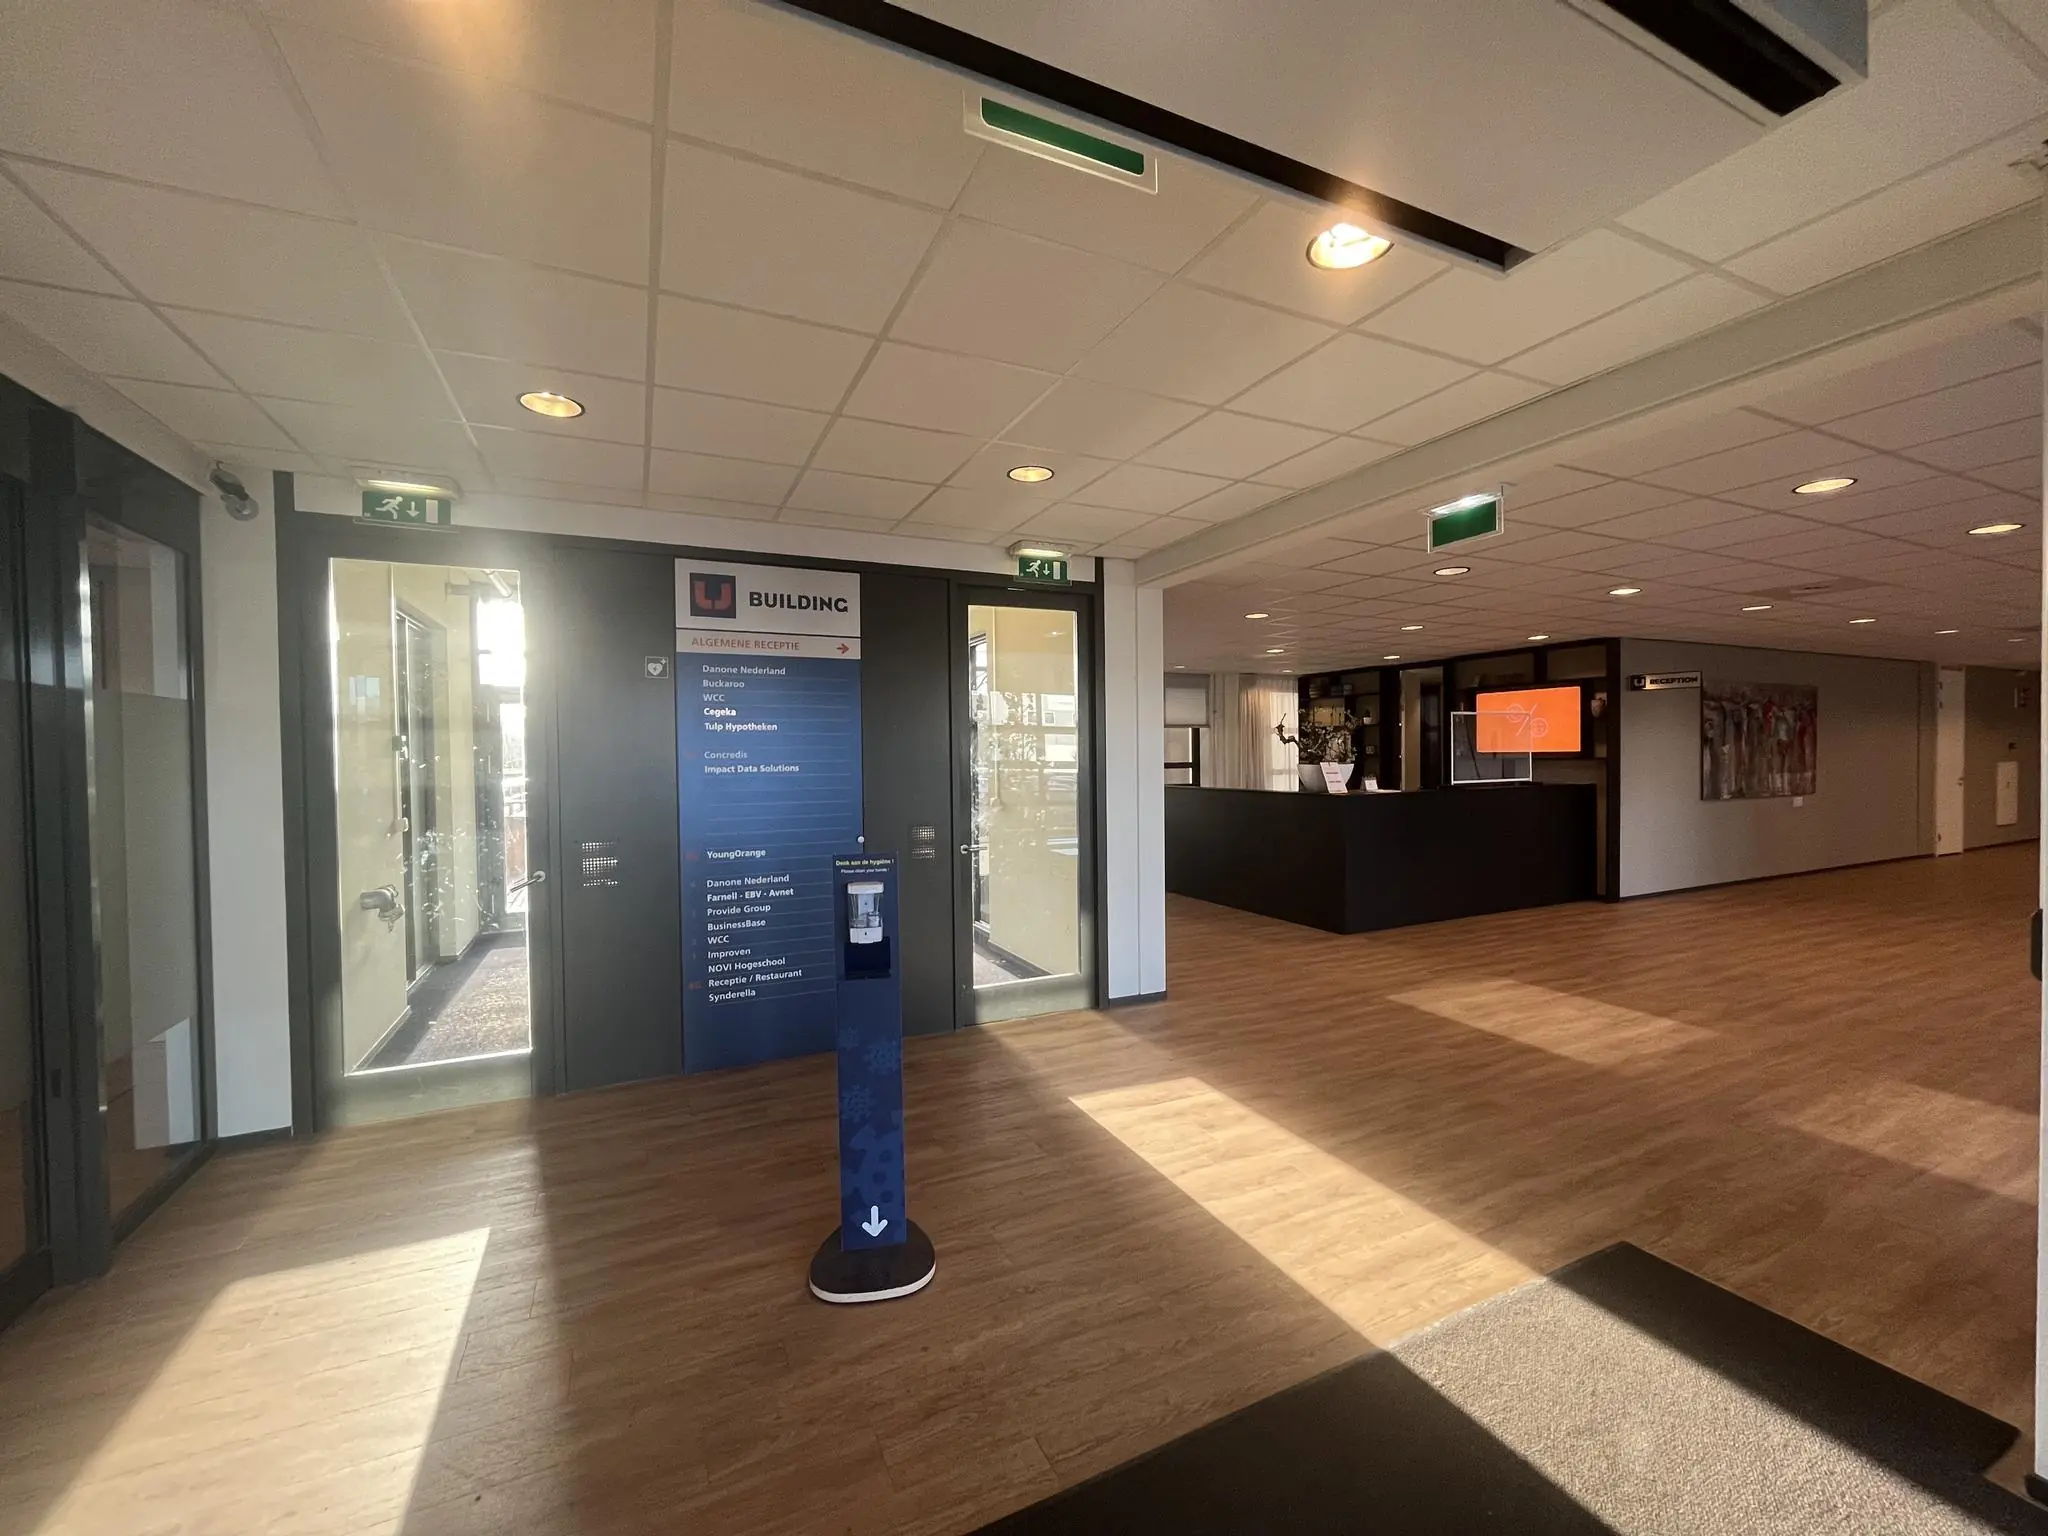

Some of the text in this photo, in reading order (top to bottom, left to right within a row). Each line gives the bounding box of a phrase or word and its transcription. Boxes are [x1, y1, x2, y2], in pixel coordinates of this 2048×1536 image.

[749, 592, 848, 612] BUILDING
[692, 637, 800, 650] ALGEMENE RECEPTIE
[703, 665, 786, 675] Danone Nederland
[703, 679, 745, 688] Buckaroo
[1649, 676, 1698, 685] RECEPTION
[703, 694, 725, 702] WCC
[703, 707, 737, 717] Cegeka
[704, 722, 778, 732] Tulp Hypotheken
[704, 750, 748, 759] Concredis
[704, 764, 800, 775] Impact Data Solutions
[707, 849, 767, 860] YoungOrange
[707, 878, 742, 888] Danone
[744, 874, 790, 885] Nederland
[707, 892, 738, 902] Farnell
[745, 891, 761, 899] EBV
[769, 888, 794, 897] Avnet
[707, 906, 741, 917] Provide
[744, 904, 771, 914] Group
[707, 919, 766, 931] BusinessBase
[708, 936, 730, 945] WCC
[708, 948, 751, 960] Improven
[708, 957, 786, 973] NOVI Hogeschool
[708, 976, 747, 988] Receptie
[755, 969, 802, 982] Restaurant
[709, 989, 756, 1002] Synderella
